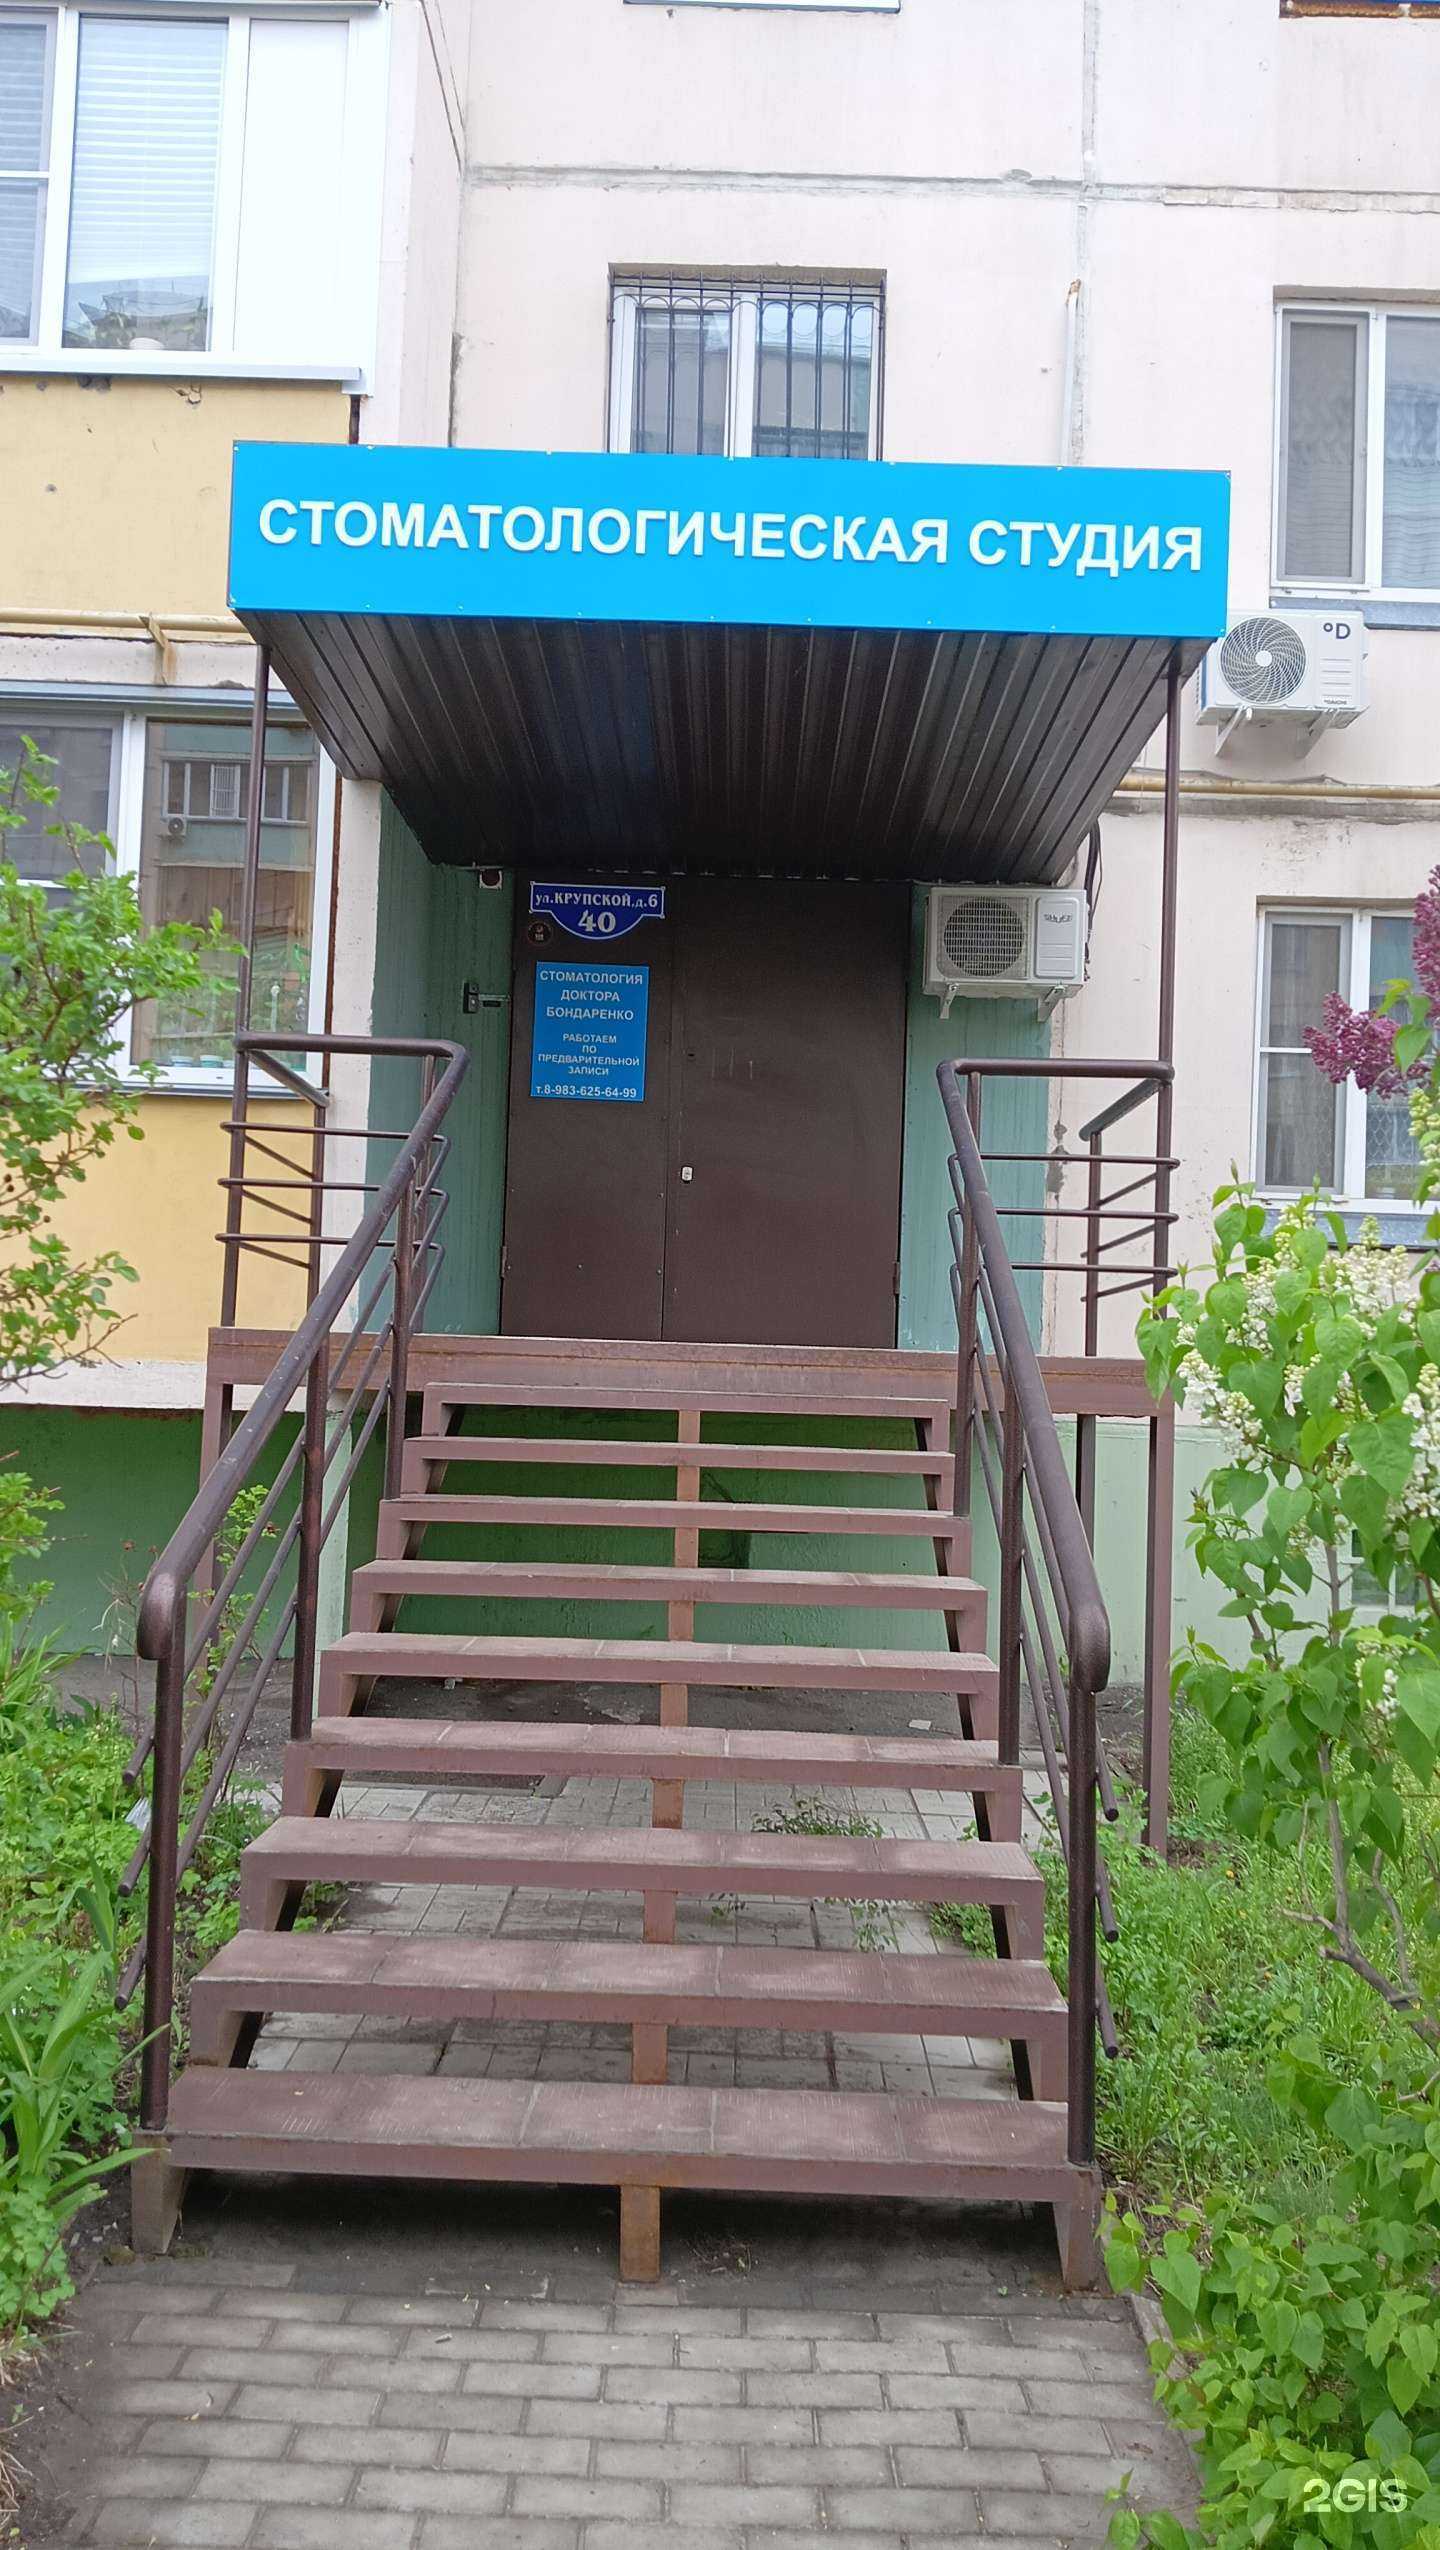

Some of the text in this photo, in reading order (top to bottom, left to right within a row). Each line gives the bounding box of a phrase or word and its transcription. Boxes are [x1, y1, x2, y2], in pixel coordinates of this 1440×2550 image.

[258, 498, 1203, 577] СТОМАТОЛОГИЧЕСКАЯ СТУДИЯ
[578, 909, 617, 933] 40
[539, 970, 644, 985] СТОМАТОЛОГИЯ
[560, 989, 620, 1002] ДОКТОРА
[546, 1006, 634, 1021] БОНДАРЕНКО
[562, 1032, 617, 1044] РАБОТАЕМ
[582, 1045, 597, 1054] ПО
[538, 1053, 640, 1067] ПРЕДВАРИТЕЛЬНОЙ
[568, 1065, 609, 1076] ЗАПИСИ
